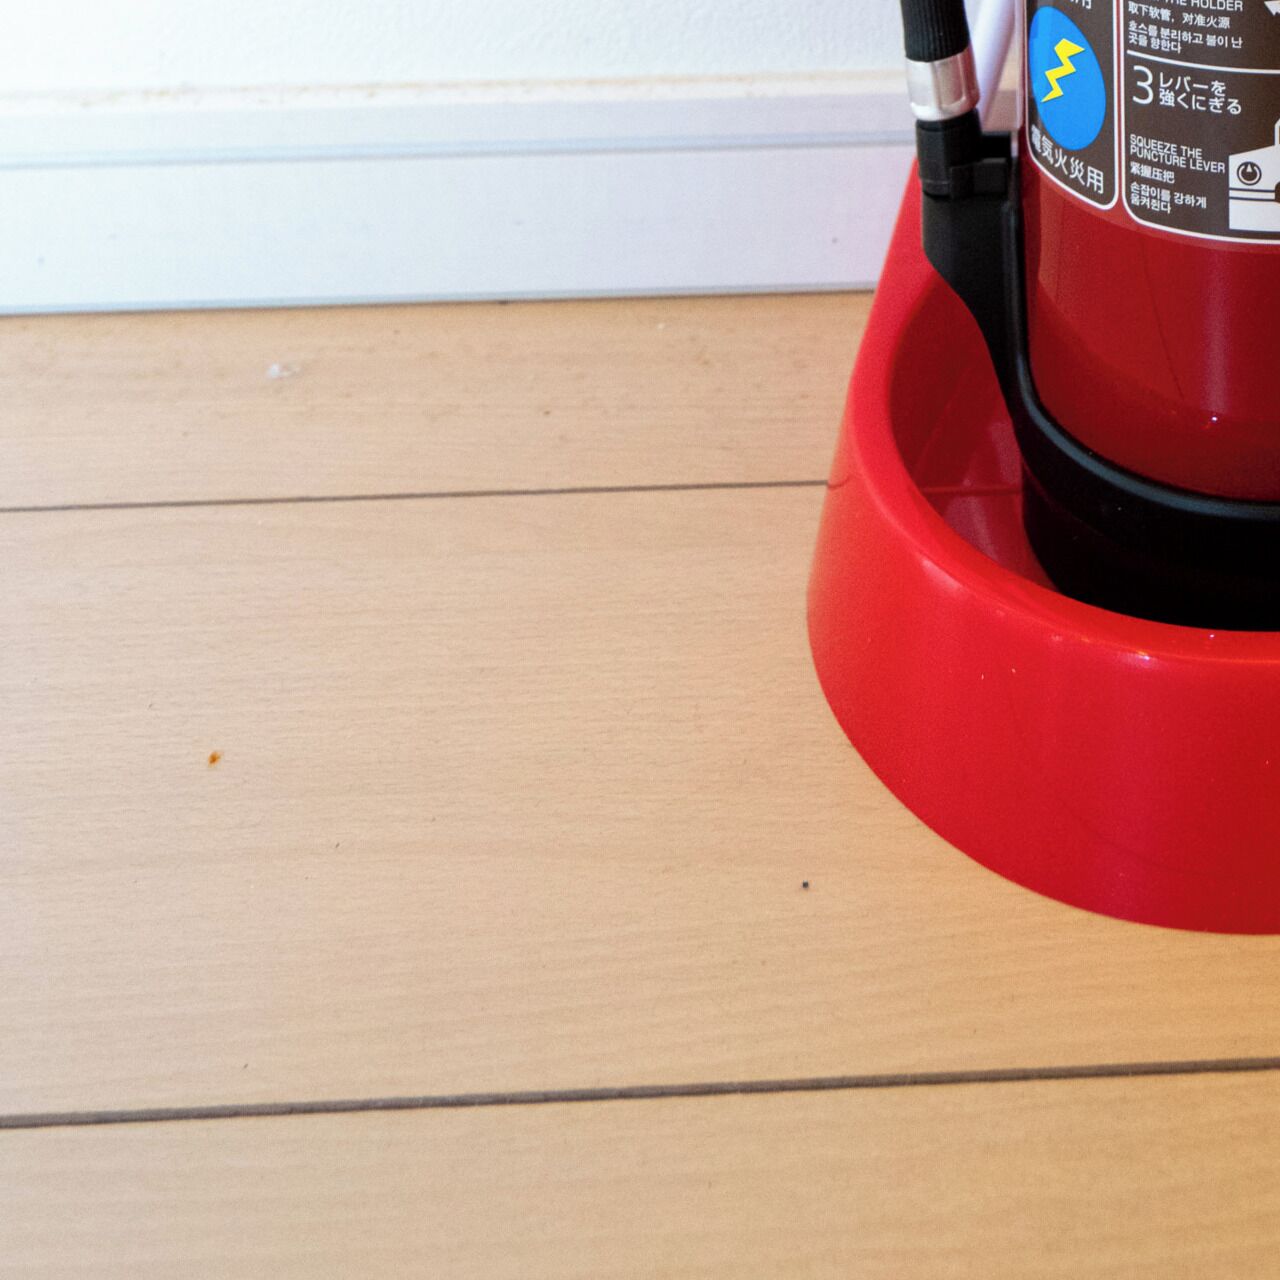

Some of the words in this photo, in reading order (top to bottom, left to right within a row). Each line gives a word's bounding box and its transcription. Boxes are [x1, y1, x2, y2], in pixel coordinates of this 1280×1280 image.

[1133, 65, 1154, 105] 3
[1159, 72, 1226, 96] レバーを
[1159, 88, 1242, 116] 強くにぎる
[1031, 124, 1104, 195] 電気火災用
[1130, 134, 1178, 155] SQUEEZE
[1180, 145, 1203, 159] THE
[1130, 145, 1187, 168] PUNCTURE
[1190, 158, 1226, 174] LEVER
